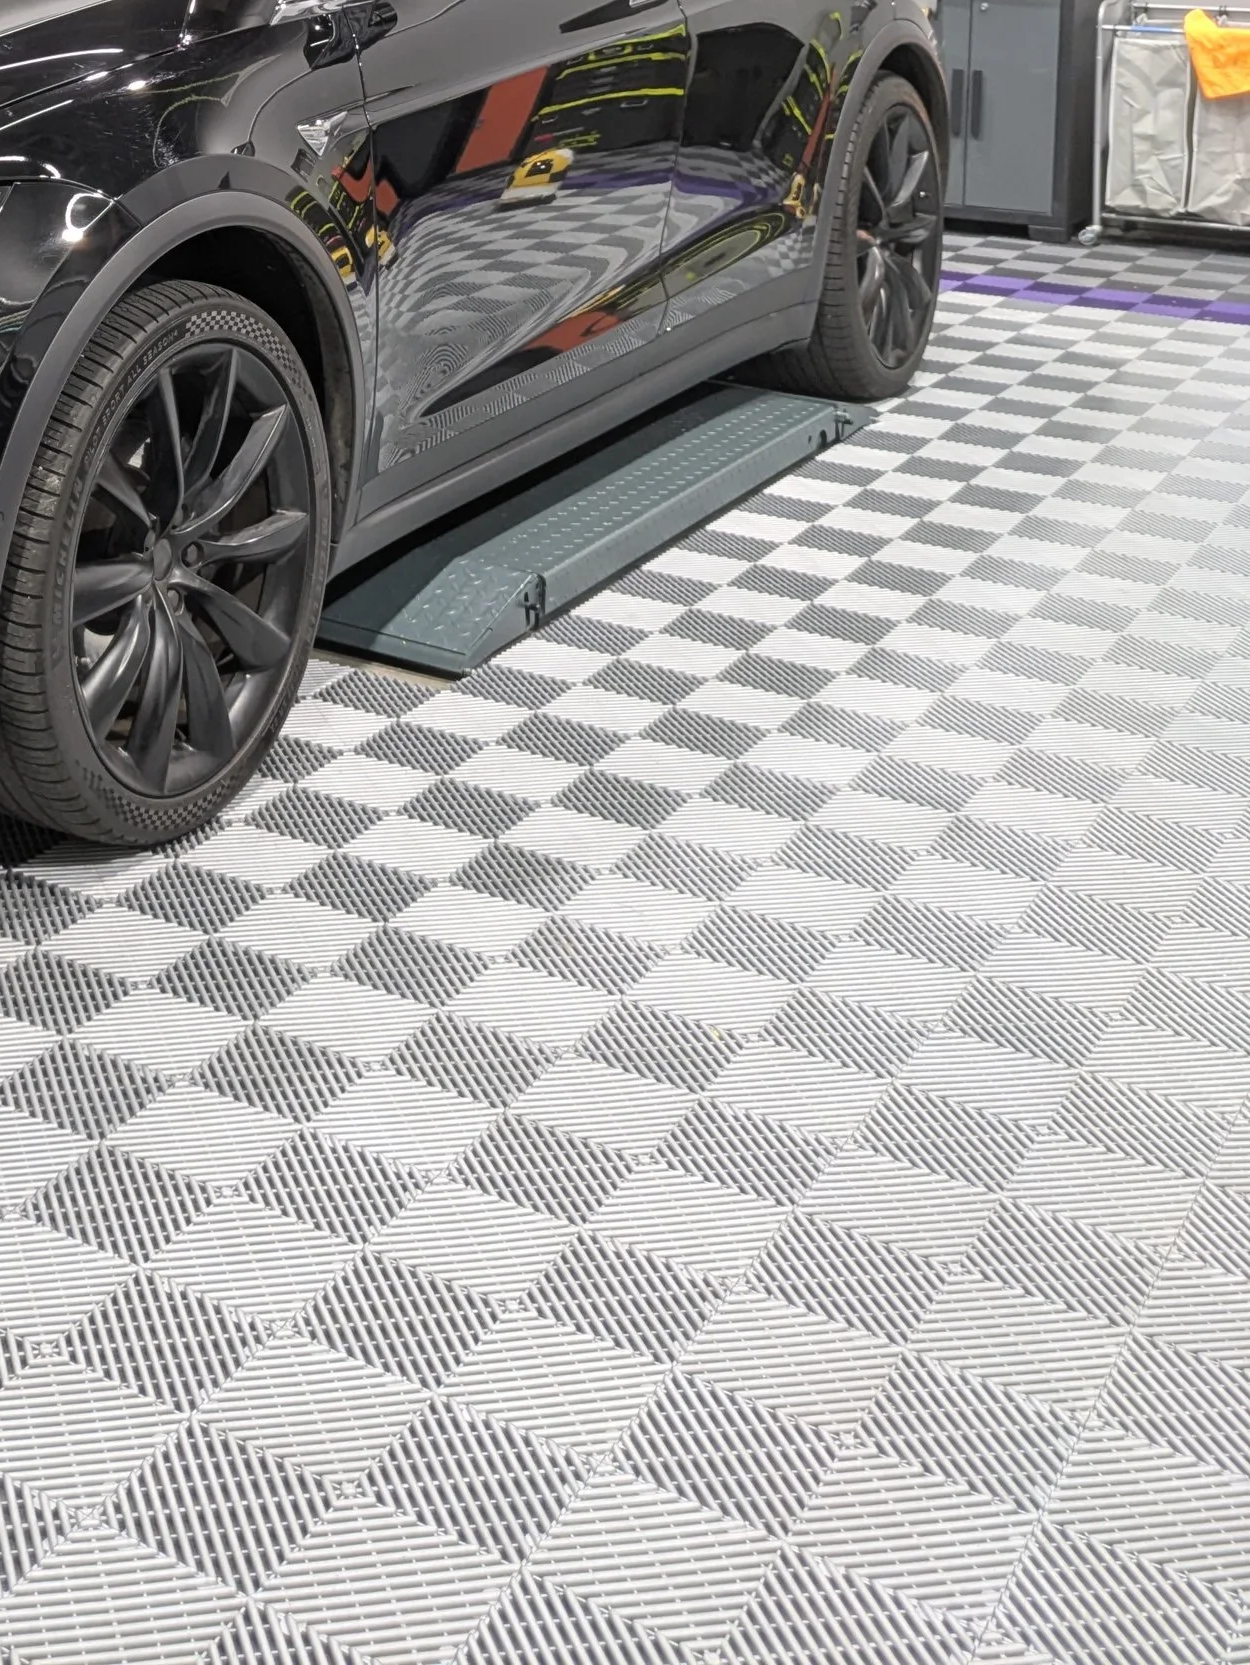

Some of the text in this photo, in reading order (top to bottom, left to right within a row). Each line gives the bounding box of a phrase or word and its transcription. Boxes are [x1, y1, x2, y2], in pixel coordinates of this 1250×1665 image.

[52, 478, 83, 626] MICHELIN
[101, 384, 125, 426] SPORT
[126, 364, 142, 384] ALL
[142, 334, 175, 366] SEASON
